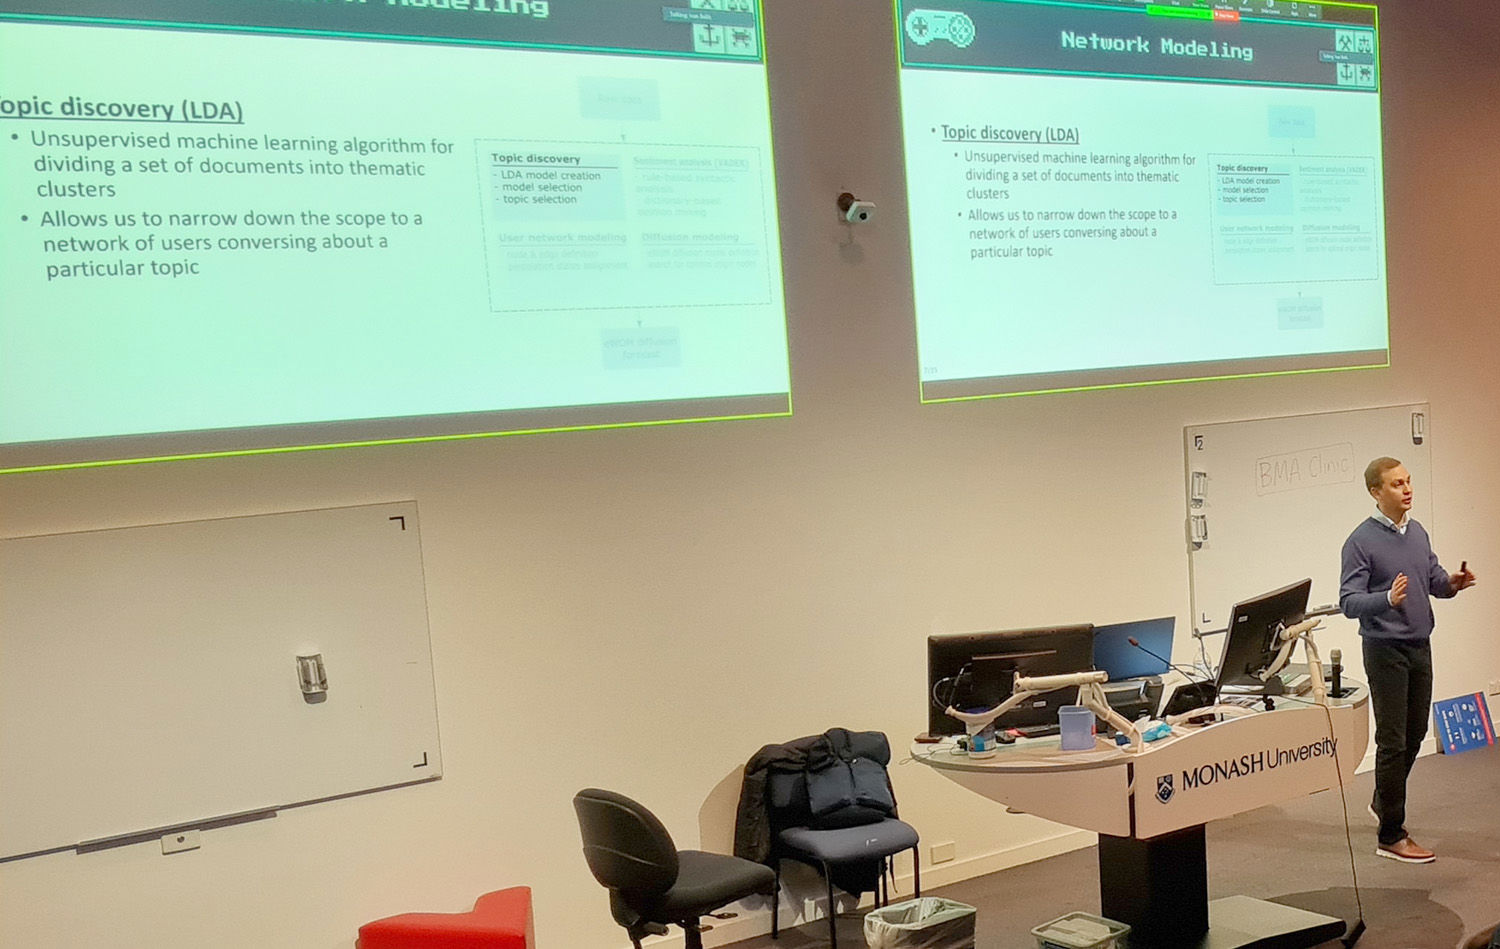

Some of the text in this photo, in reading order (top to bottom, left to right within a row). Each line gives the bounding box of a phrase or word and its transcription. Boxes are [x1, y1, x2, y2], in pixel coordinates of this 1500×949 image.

[1061, 31, 1254, 61] Network Modeling
[0, 96, 243, 123] opic discovery (LDA)
[941, 125, 1080, 144] Topic discovery (LDA)
[31, 130, 454, 156] Unsupervised machine learning algorithm for
[34, 155, 426, 176] dividing a set of documents into thematic
[492, 153, 580, 165] Topic discovery
[964, 150, 1196, 167] Unsupervised machine learning algorithm for
[501, 170, 601, 181] LDA model creation
[965, 169, 1180, 184] dividing a set of documents into thematic
[1217, 164, 1268, 174] Topic discovery
[37, 180, 116, 197] clusters
[502, 182, 582, 192] model selection
[1236, 177, 1254, 185] model
[503, 194, 577, 205] topic selection
[967, 187, 1009, 200] clusters
[1222, 195, 1265, 204] topic selection
[40, 210, 423, 228] Allows us to narrow down the scope to a
[968, 208, 1177, 222] Allows us to narrow down the scope to a
[969, 226, 1157, 240] network of users conversing about a
[44, 233, 388, 252] network of users conversing about a
[971, 246, 1054, 260] particular topic
[47, 259, 200, 281] particular topic
[1259, 453, 1349, 487] BMA Clinic
[1182, 736, 1338, 791] MONASH University
